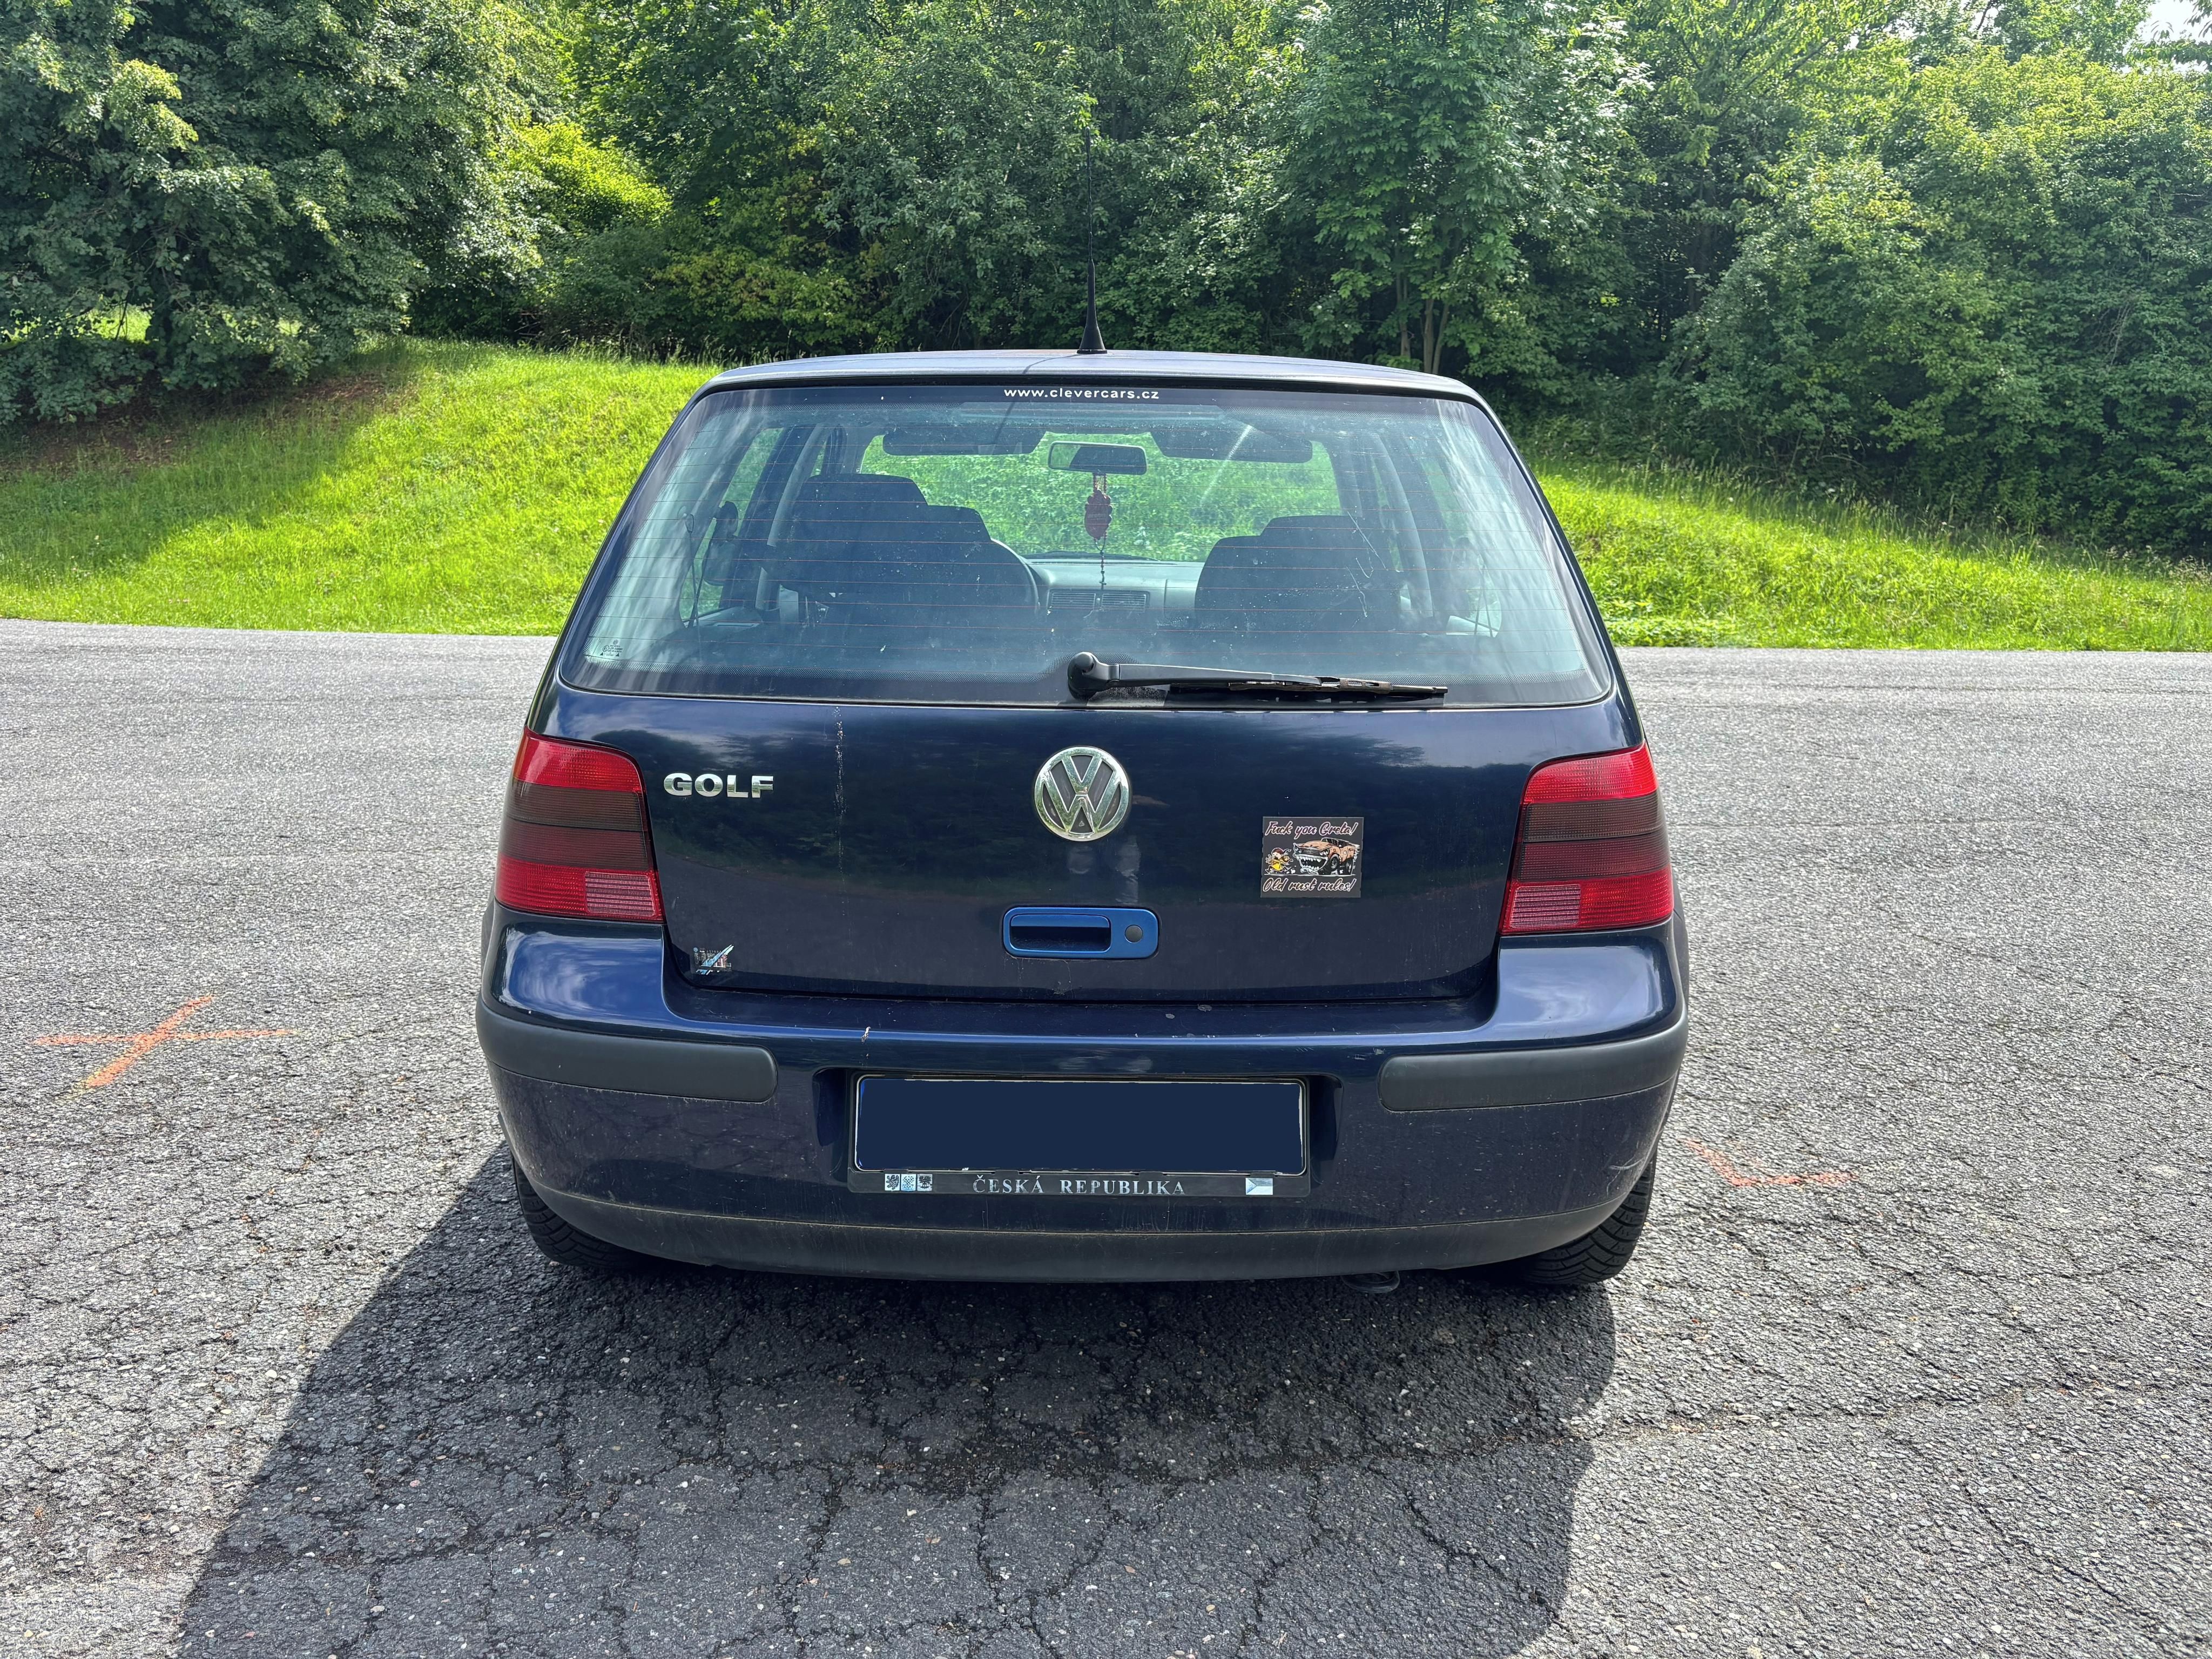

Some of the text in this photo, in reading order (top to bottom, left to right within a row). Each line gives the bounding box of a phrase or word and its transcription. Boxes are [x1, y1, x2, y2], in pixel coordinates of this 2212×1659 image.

[1004, 388, 1159, 399] www.clevercars.cz
[664, 773, 773, 798] GOLF
[1265, 821, 1358, 839] Fuck you Greta!
[1263, 878, 1357, 892] Old rust rules!
[973, 1175, 1186, 1195] ČESKÁ REPUBLIKA
